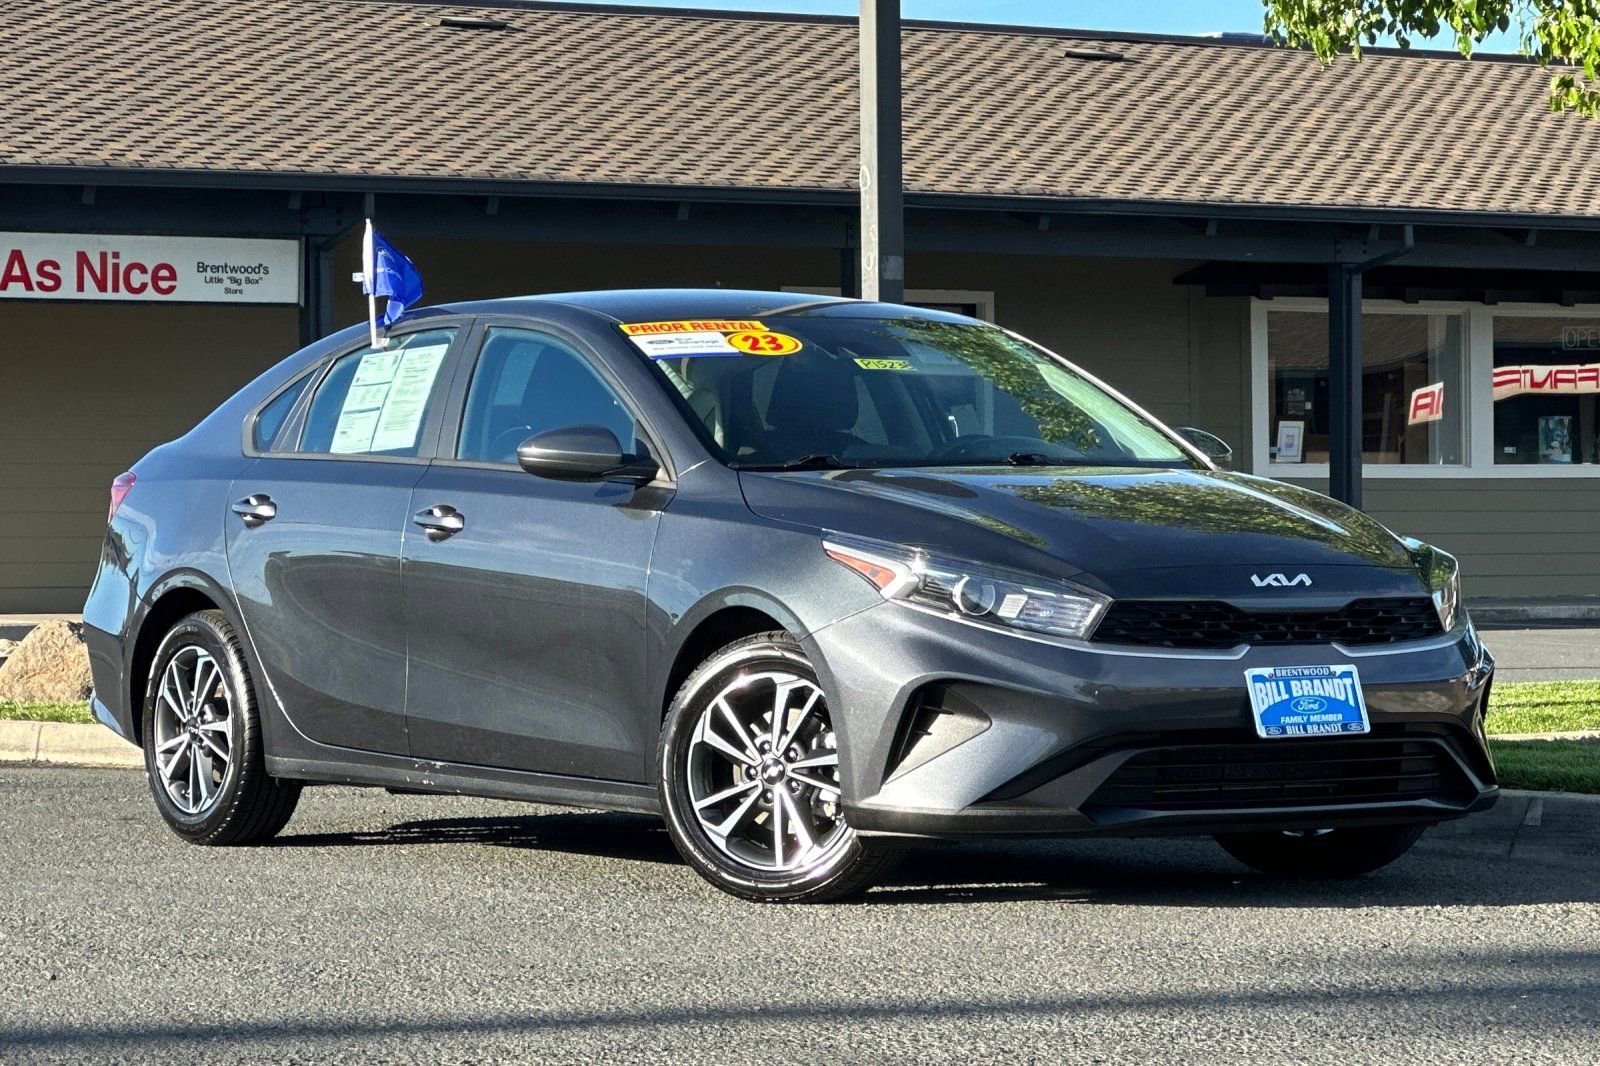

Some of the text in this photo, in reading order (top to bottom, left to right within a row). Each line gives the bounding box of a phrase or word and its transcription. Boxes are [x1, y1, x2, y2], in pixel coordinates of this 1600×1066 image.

[0, 249, 178, 295] As Nice
[196, 261, 269, 275] Brentwood's
[204, 275, 224, 284] Little
[223, 287, 243, 295] Store
[628, 321, 761, 334] PRIOR RENTAL
[742, 335, 784, 352] 23
[1565, 329, 1600, 348] OPE
[1250, 573, 1313, 588] KIA
[1275, 667, 1330, 677] BRENTWOOD
[1254, 677, 1355, 714] BILL BRANDT
[1297, 698, 1319, 710] Ford
[1280, 714, 1342, 724] FAMILY MEMBER
[1286, 723, 1343, 735] BILL BRANDT
